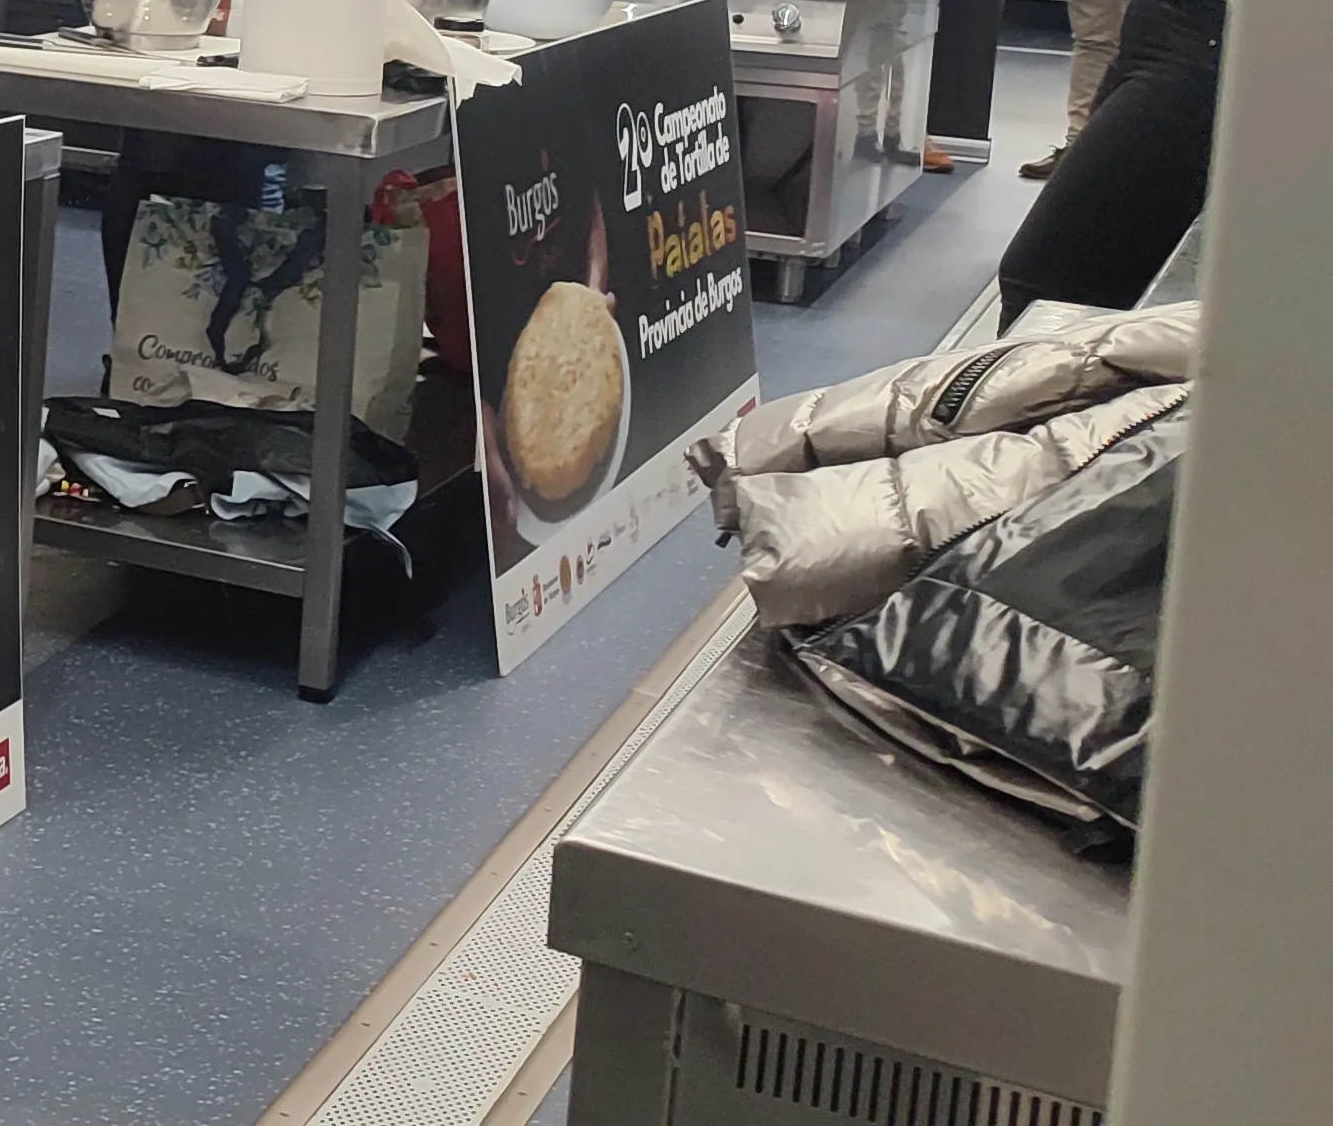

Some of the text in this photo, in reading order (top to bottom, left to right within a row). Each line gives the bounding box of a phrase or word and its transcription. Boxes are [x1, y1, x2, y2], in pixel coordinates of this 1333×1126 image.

[654, 85, 727, 147] Campeonato
[661, 122, 730, 194] de Tortilla de
[505, 172, 560, 242] Burgos
[638, 266, 743, 359] Provincia de Burgos
